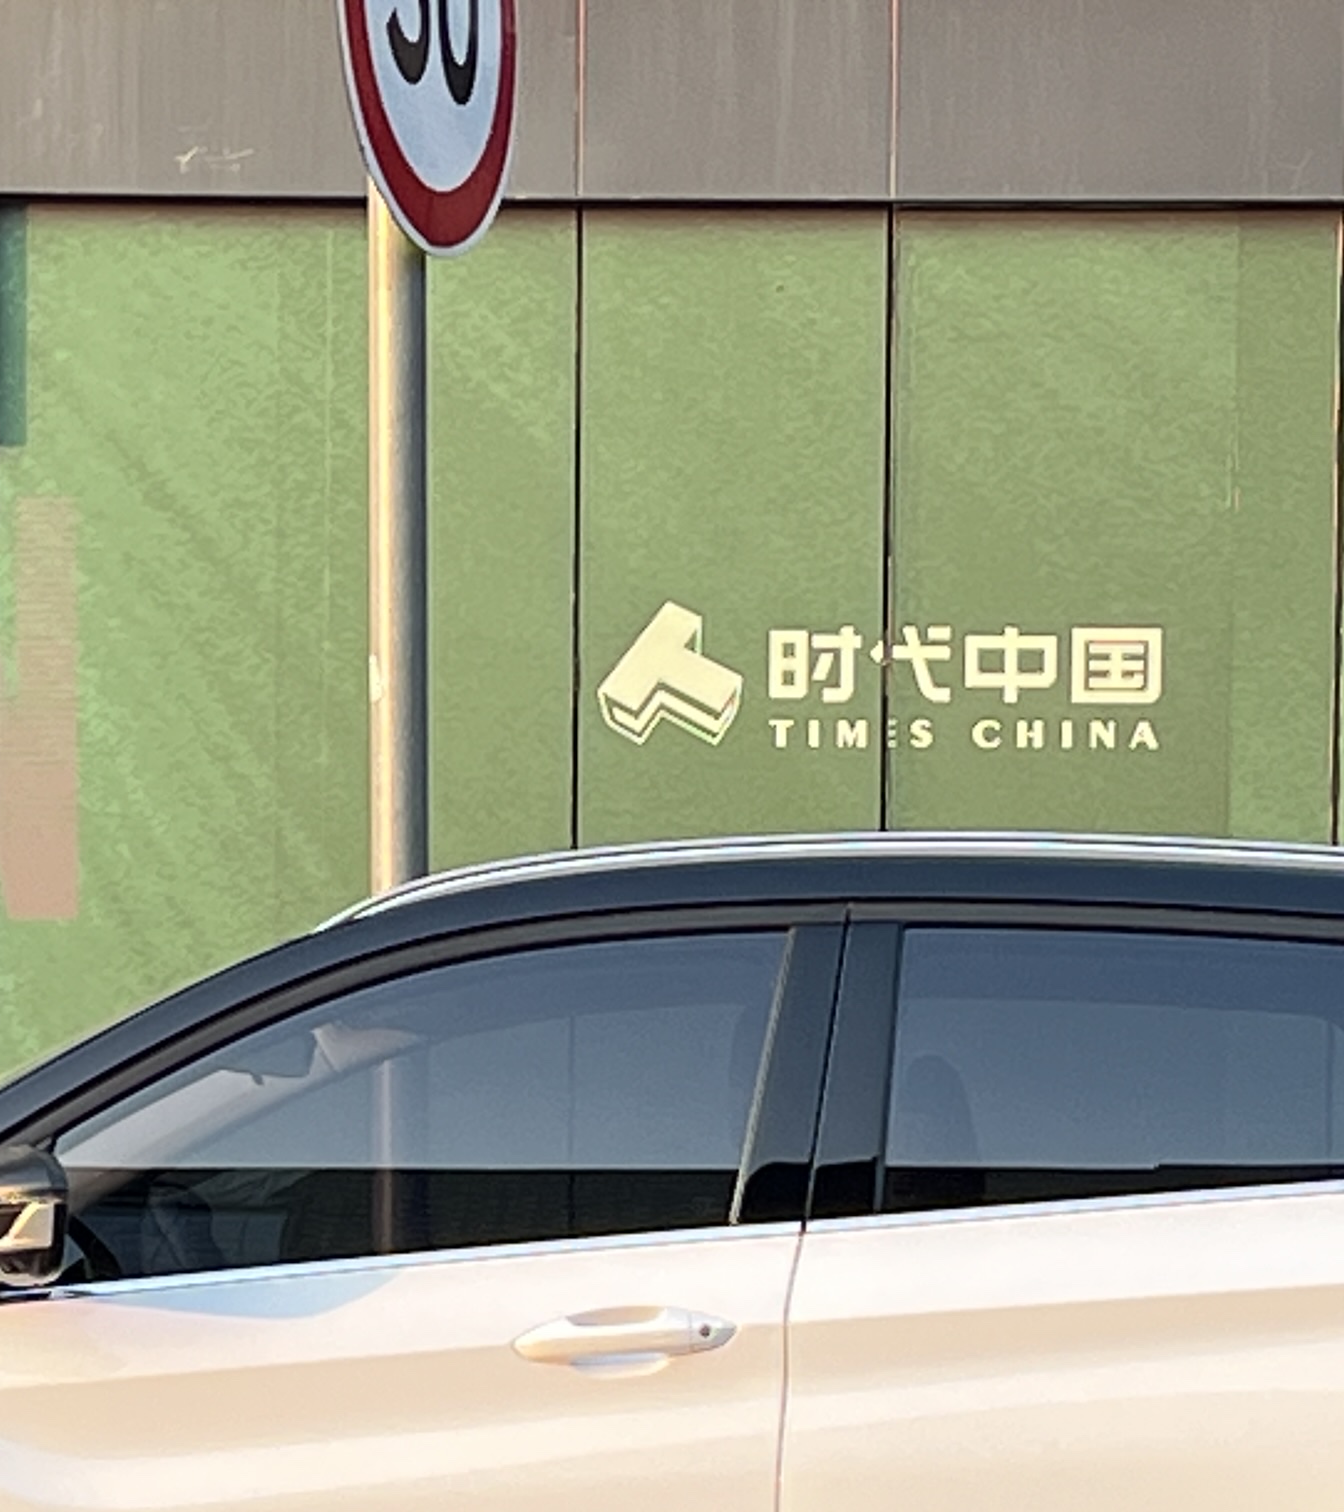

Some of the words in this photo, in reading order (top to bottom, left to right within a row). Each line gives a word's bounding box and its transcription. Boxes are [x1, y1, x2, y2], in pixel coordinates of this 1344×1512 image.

[768, 625, 1163, 704] 时代中国
[971, 719, 1159, 750] CHINA
